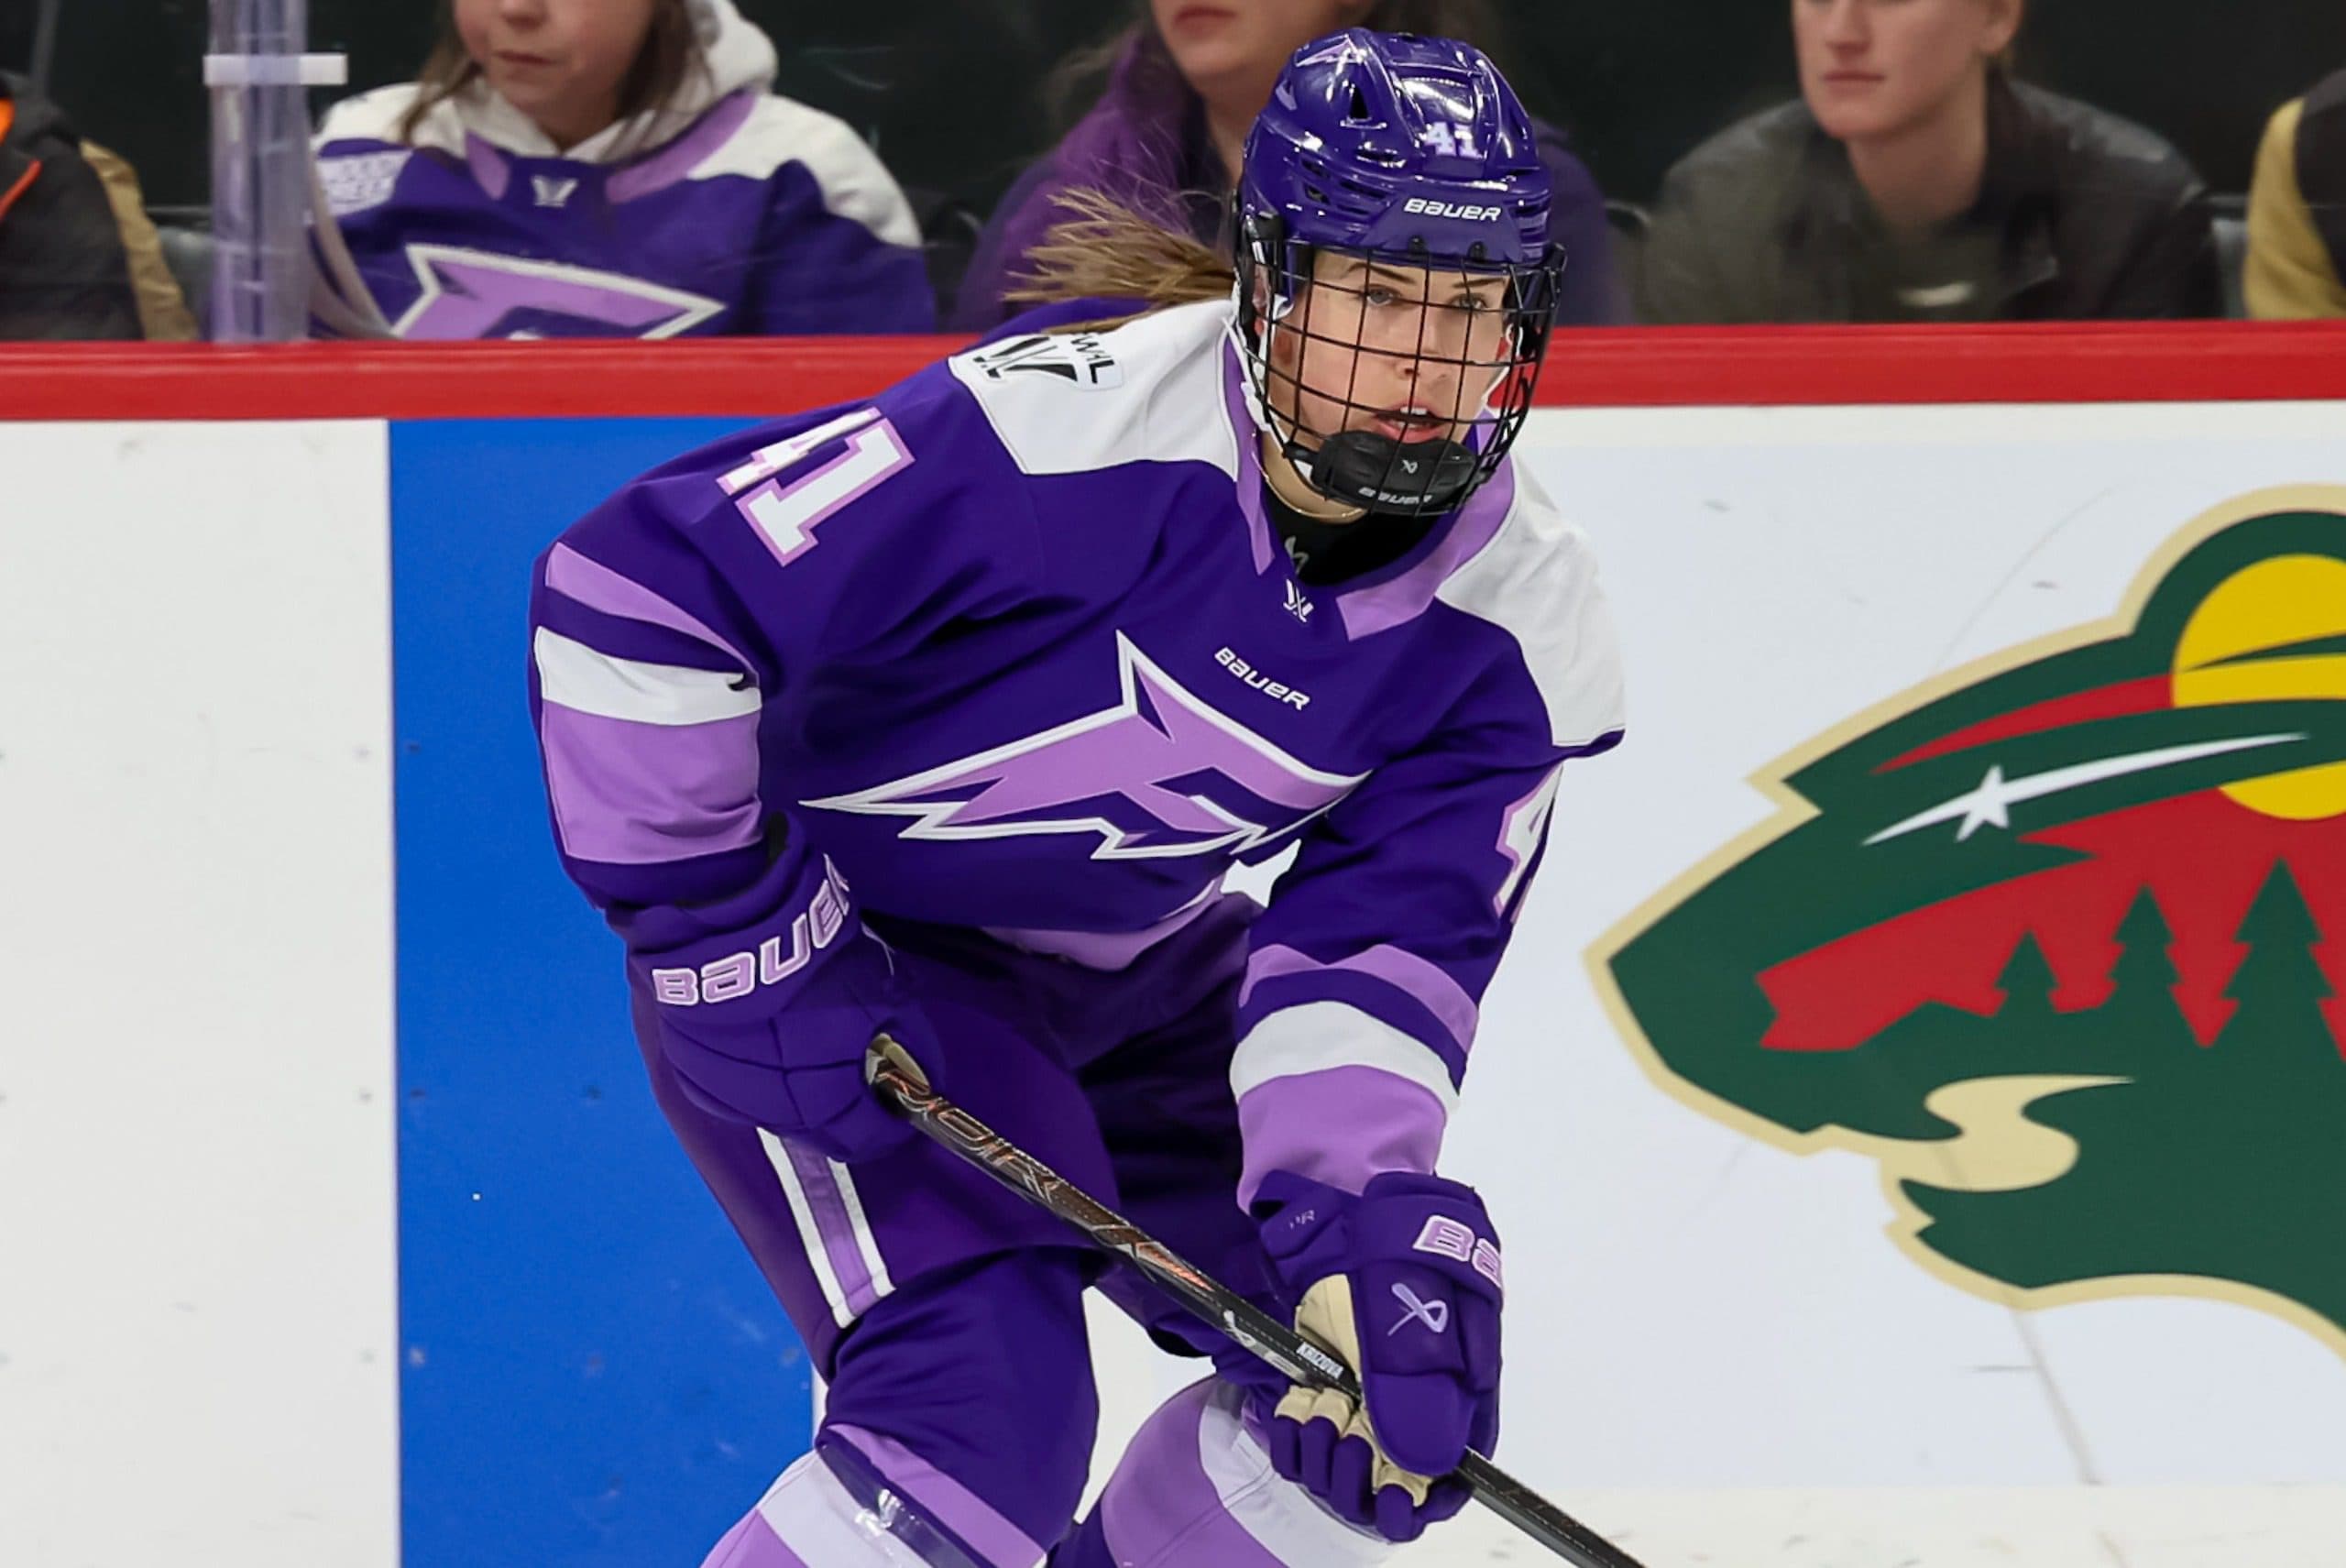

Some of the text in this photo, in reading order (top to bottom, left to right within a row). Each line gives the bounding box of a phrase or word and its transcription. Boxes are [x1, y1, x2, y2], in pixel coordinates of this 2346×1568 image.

[1422, 120, 1486, 159] 41
[1403, 197, 1501, 222] BAUER
[1214, 646, 1310, 710] BAUER
[1493, 762, 1563, 924] 4
